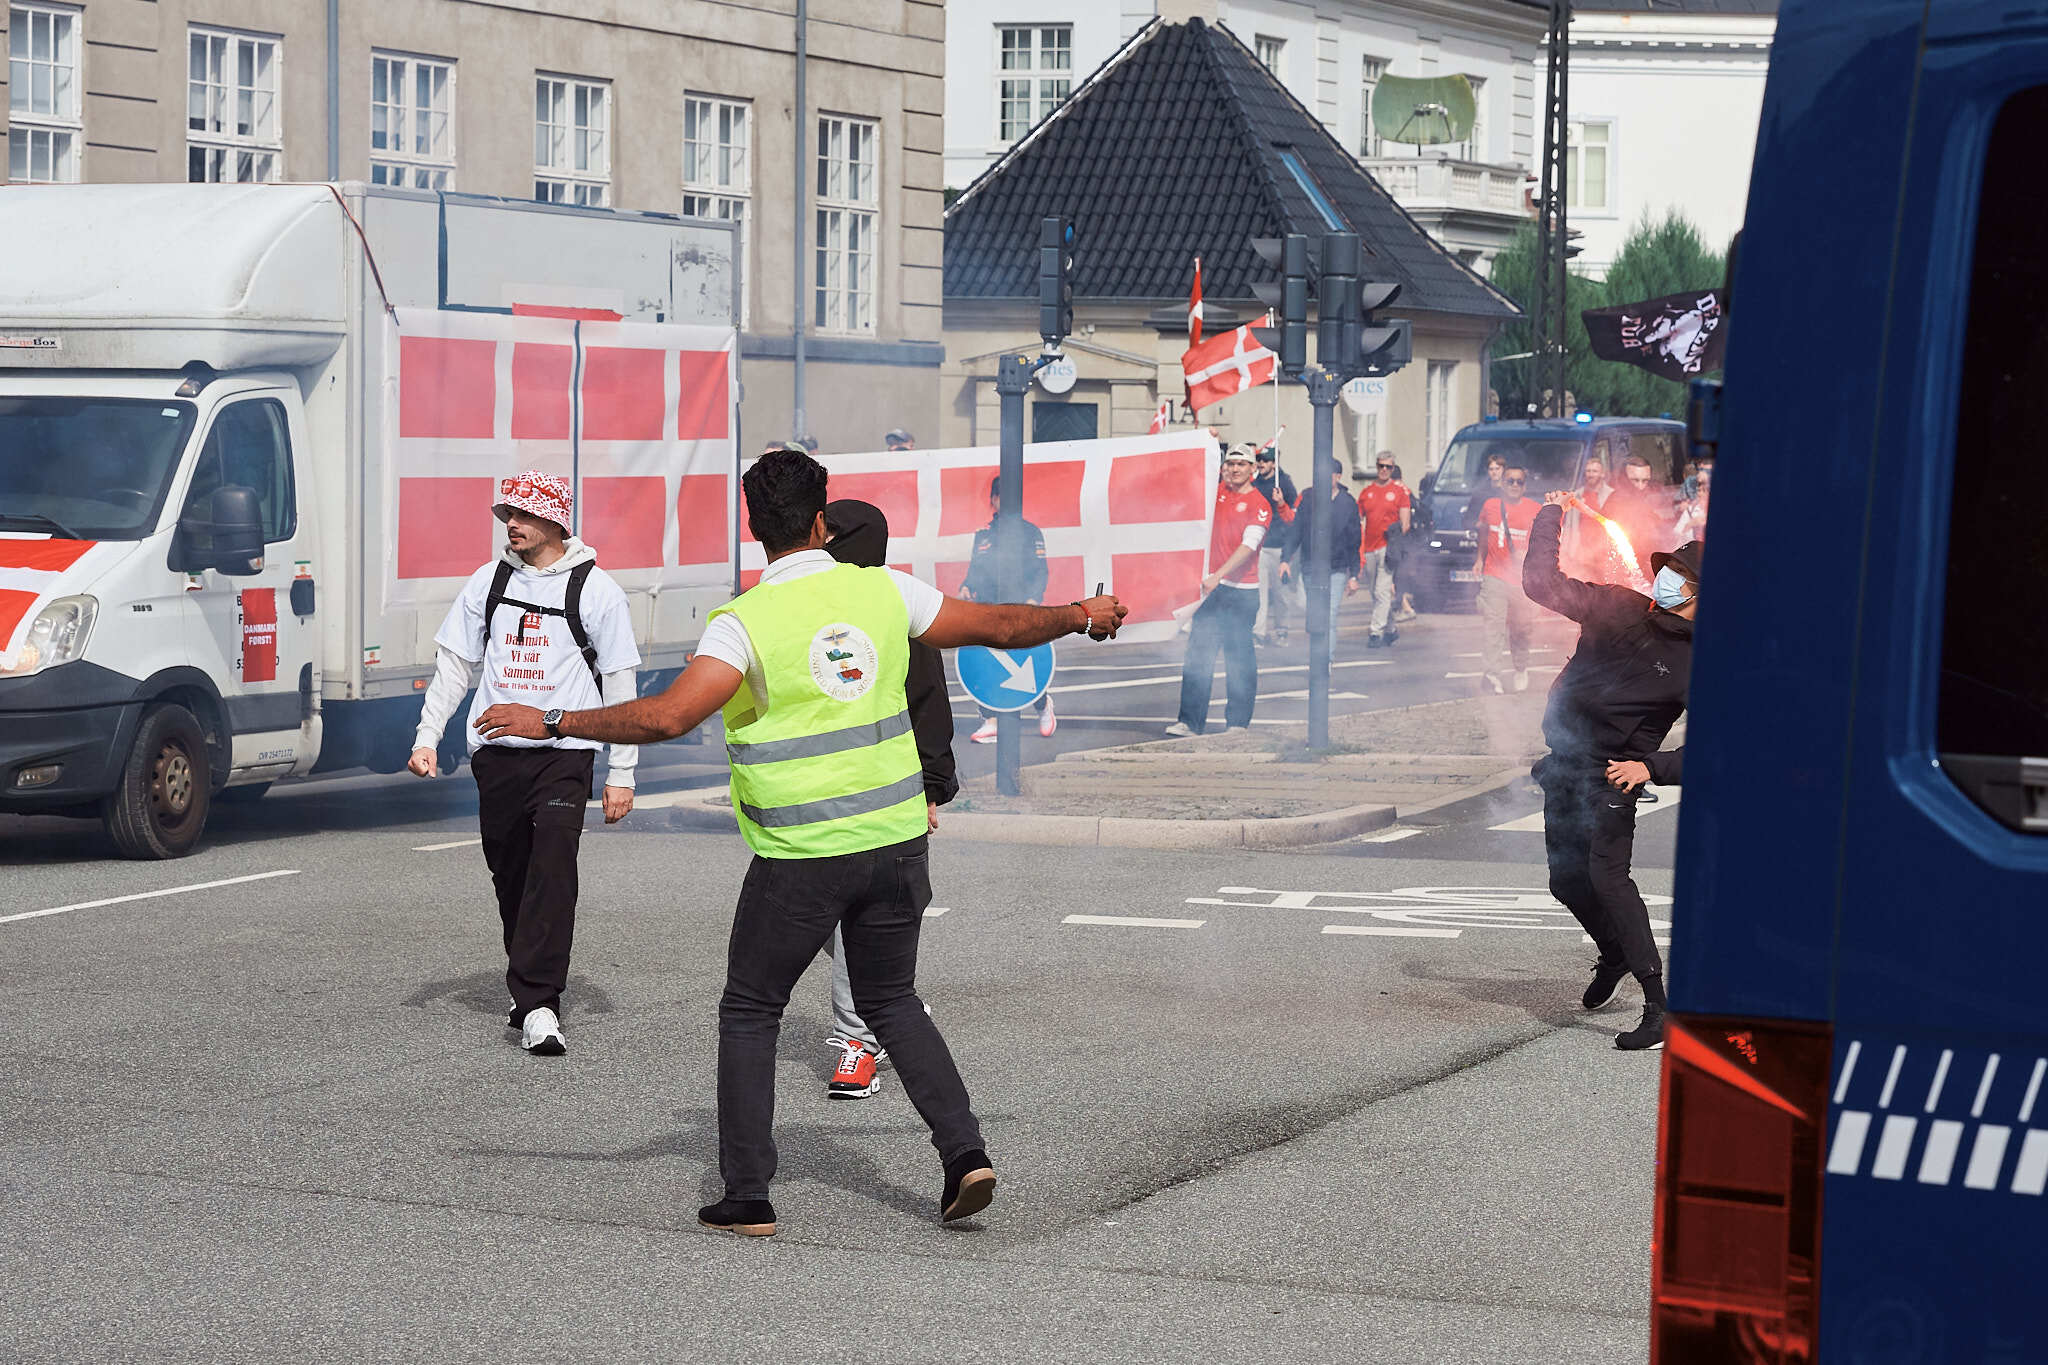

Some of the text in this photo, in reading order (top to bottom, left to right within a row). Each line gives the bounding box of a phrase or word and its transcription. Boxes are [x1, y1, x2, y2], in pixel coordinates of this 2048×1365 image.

[244, 623, 276, 634] DANMARK
[511, 650, 521, 662] Vi
[523, 650, 541, 662] står
[502, 666, 544, 680] Sammen
